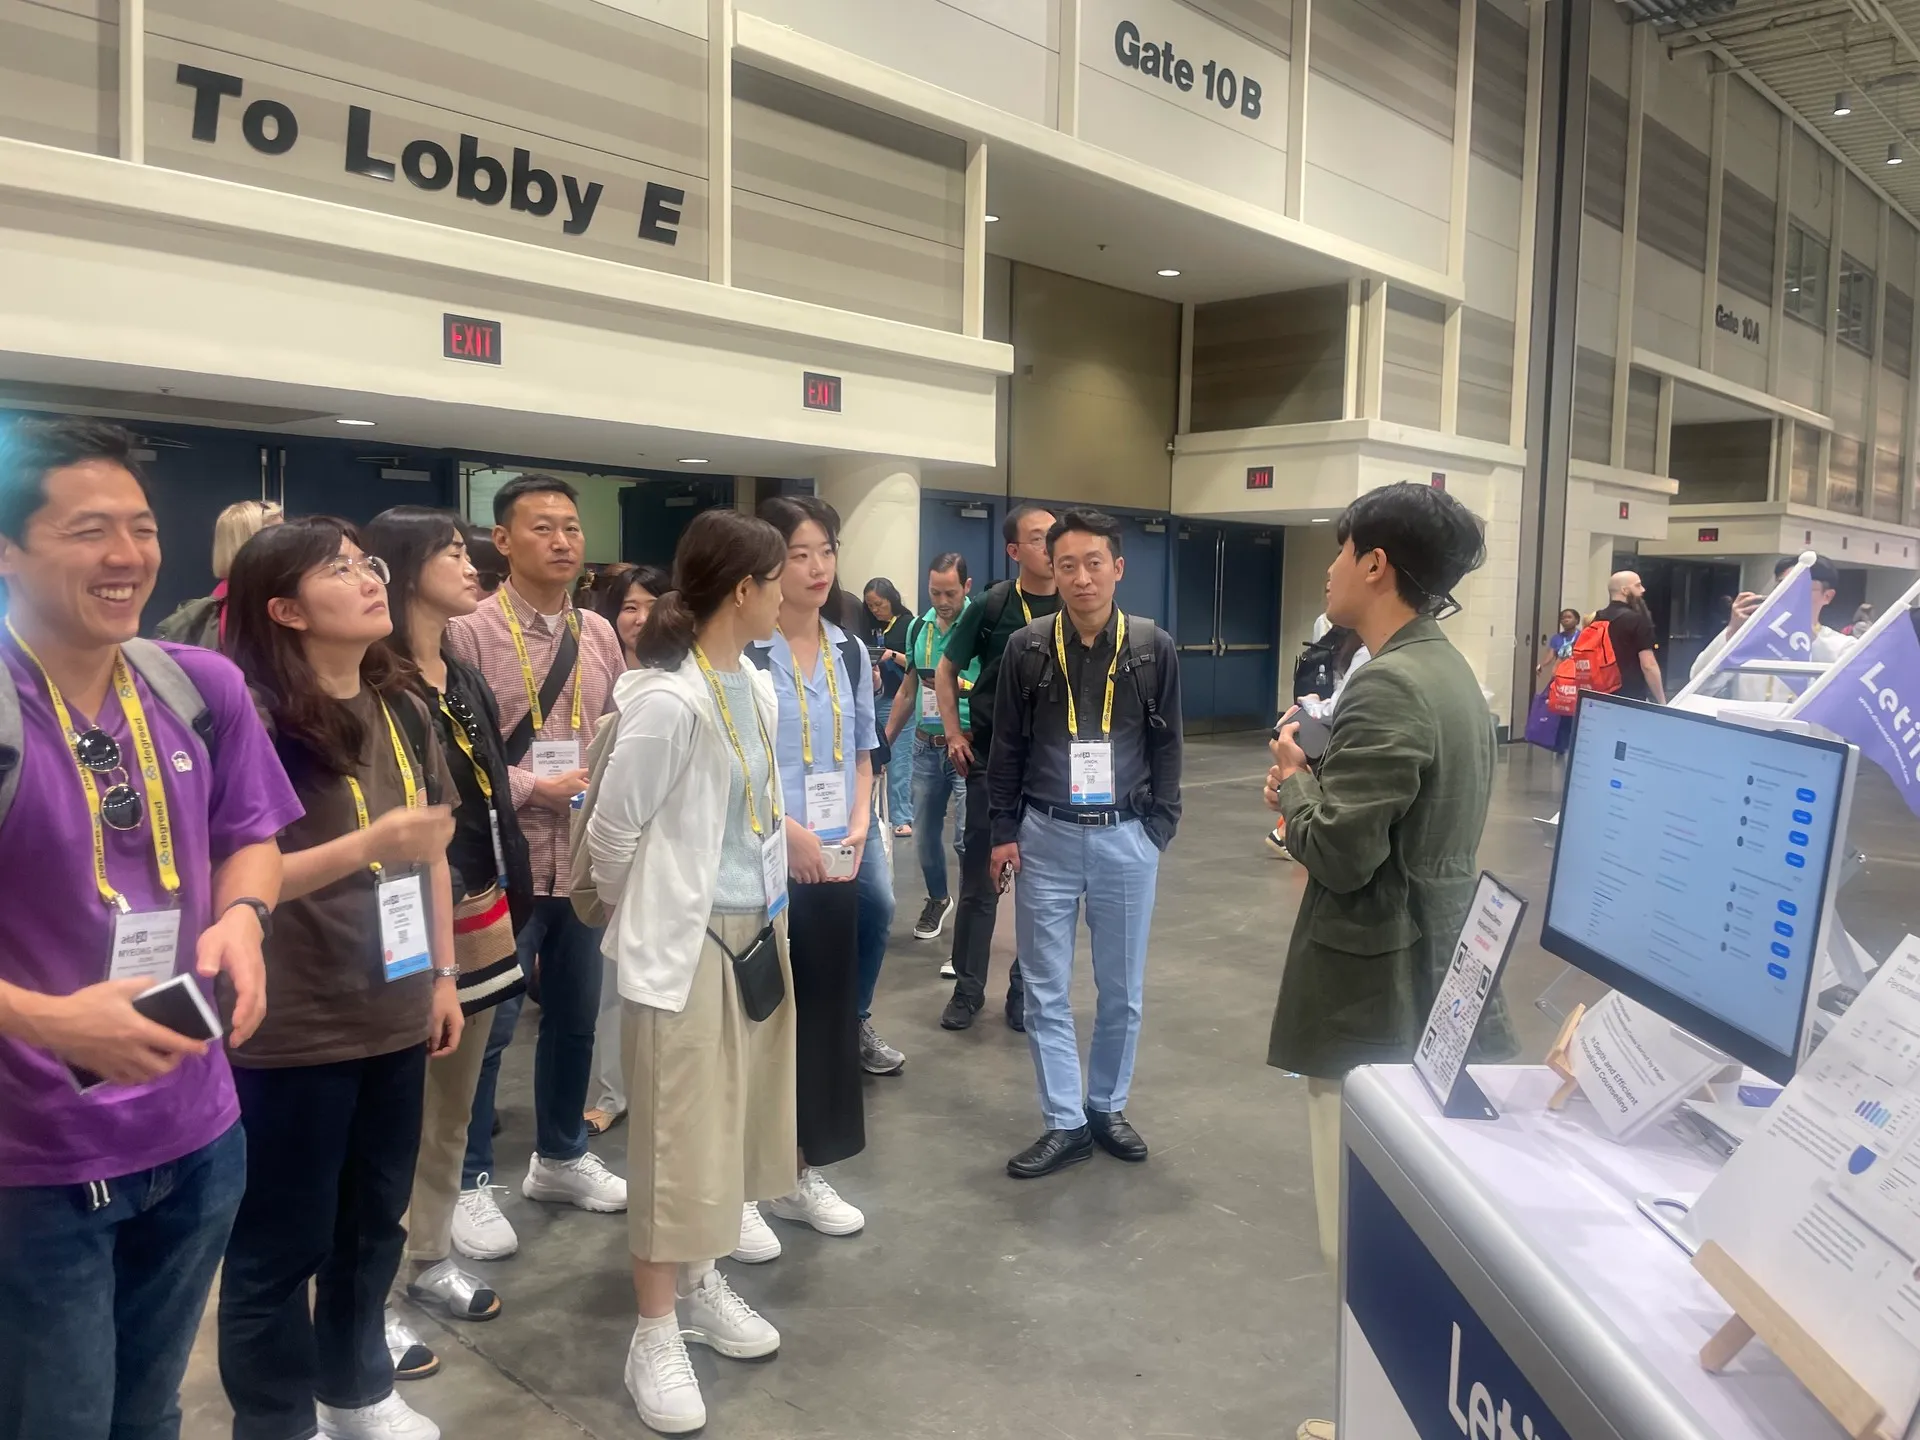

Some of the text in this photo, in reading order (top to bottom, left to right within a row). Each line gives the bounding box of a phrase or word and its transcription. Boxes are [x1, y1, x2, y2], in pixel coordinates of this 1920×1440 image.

[1115, 20, 1194, 92] Gate
[177, 64, 685, 245] To Lobby E
[451, 322, 493, 358] EXIT
[1715, 304, 1739, 334] Gate
[808, 380, 836, 407] EXIT
[1768, 611, 1812, 660] Le
[133, 717, 153, 763] degreed
[1593, 1041, 1607, 1062] Depth
[1604, 1061, 1616, 1075] and
[1613, 1073, 1638, 1106] Efficient
[1598, 1071, 1629, 1113] Counseling
